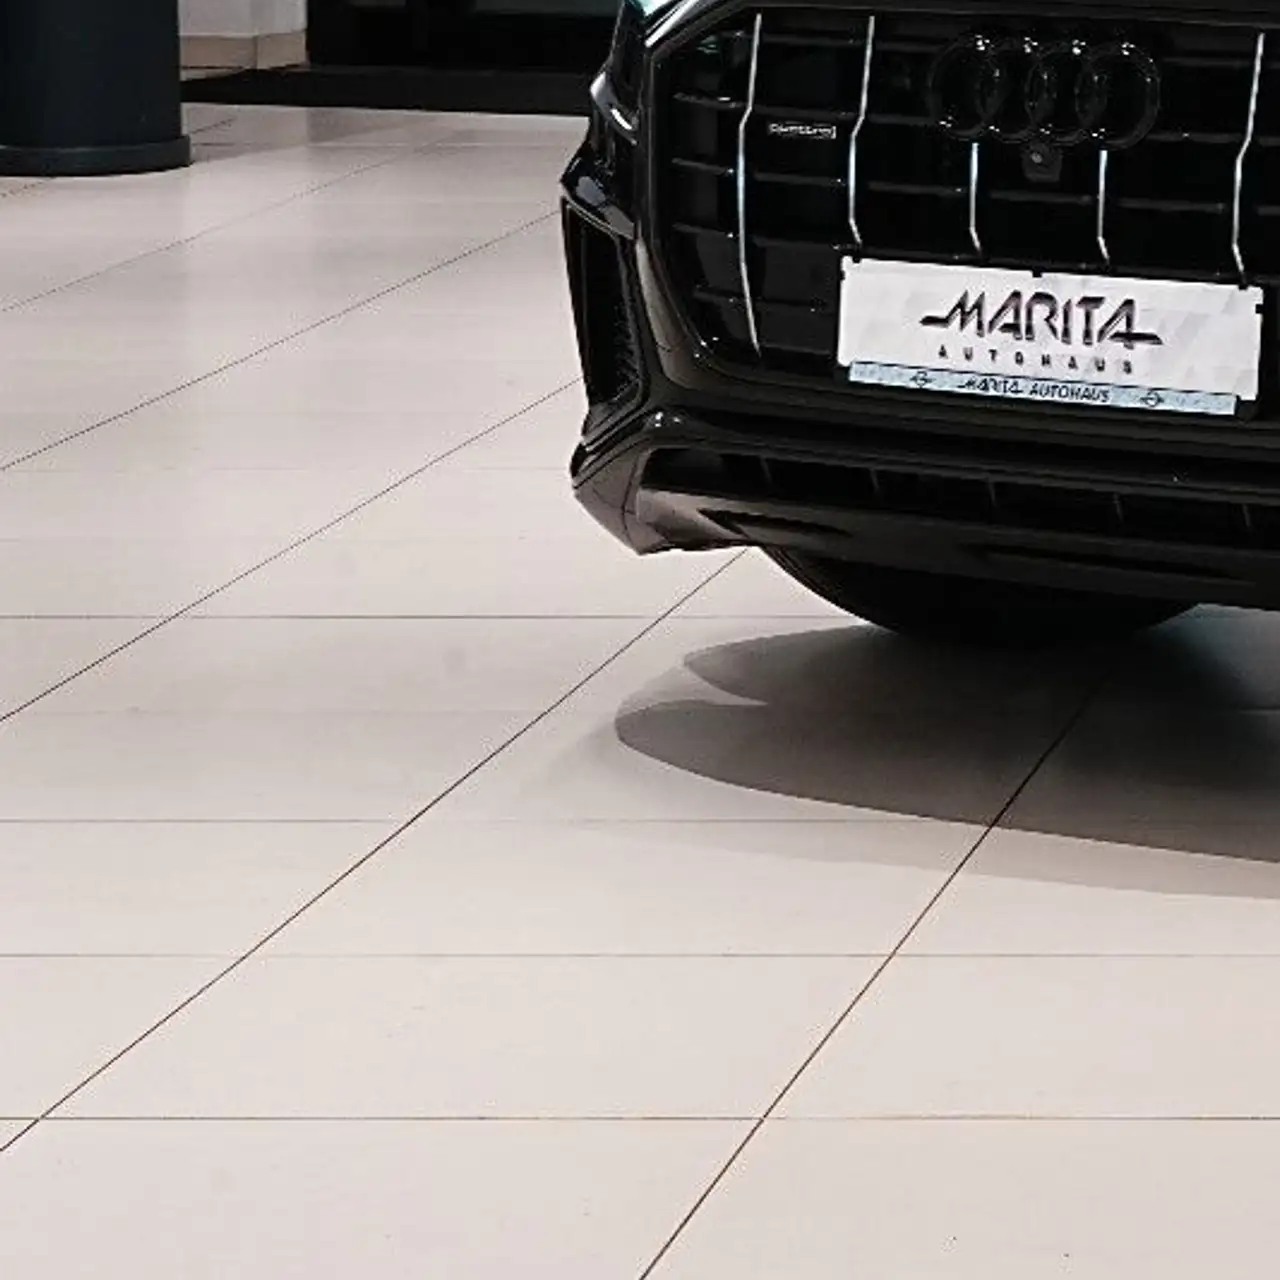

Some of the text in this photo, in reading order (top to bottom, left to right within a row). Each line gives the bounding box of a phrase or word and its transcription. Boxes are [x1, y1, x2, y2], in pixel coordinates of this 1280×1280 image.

[920, 290, 1163, 349] MARITA
[938, 345, 1132, 374] AUTOHAUS
[1029, 384, 1110, 403] AUTOHAUS
